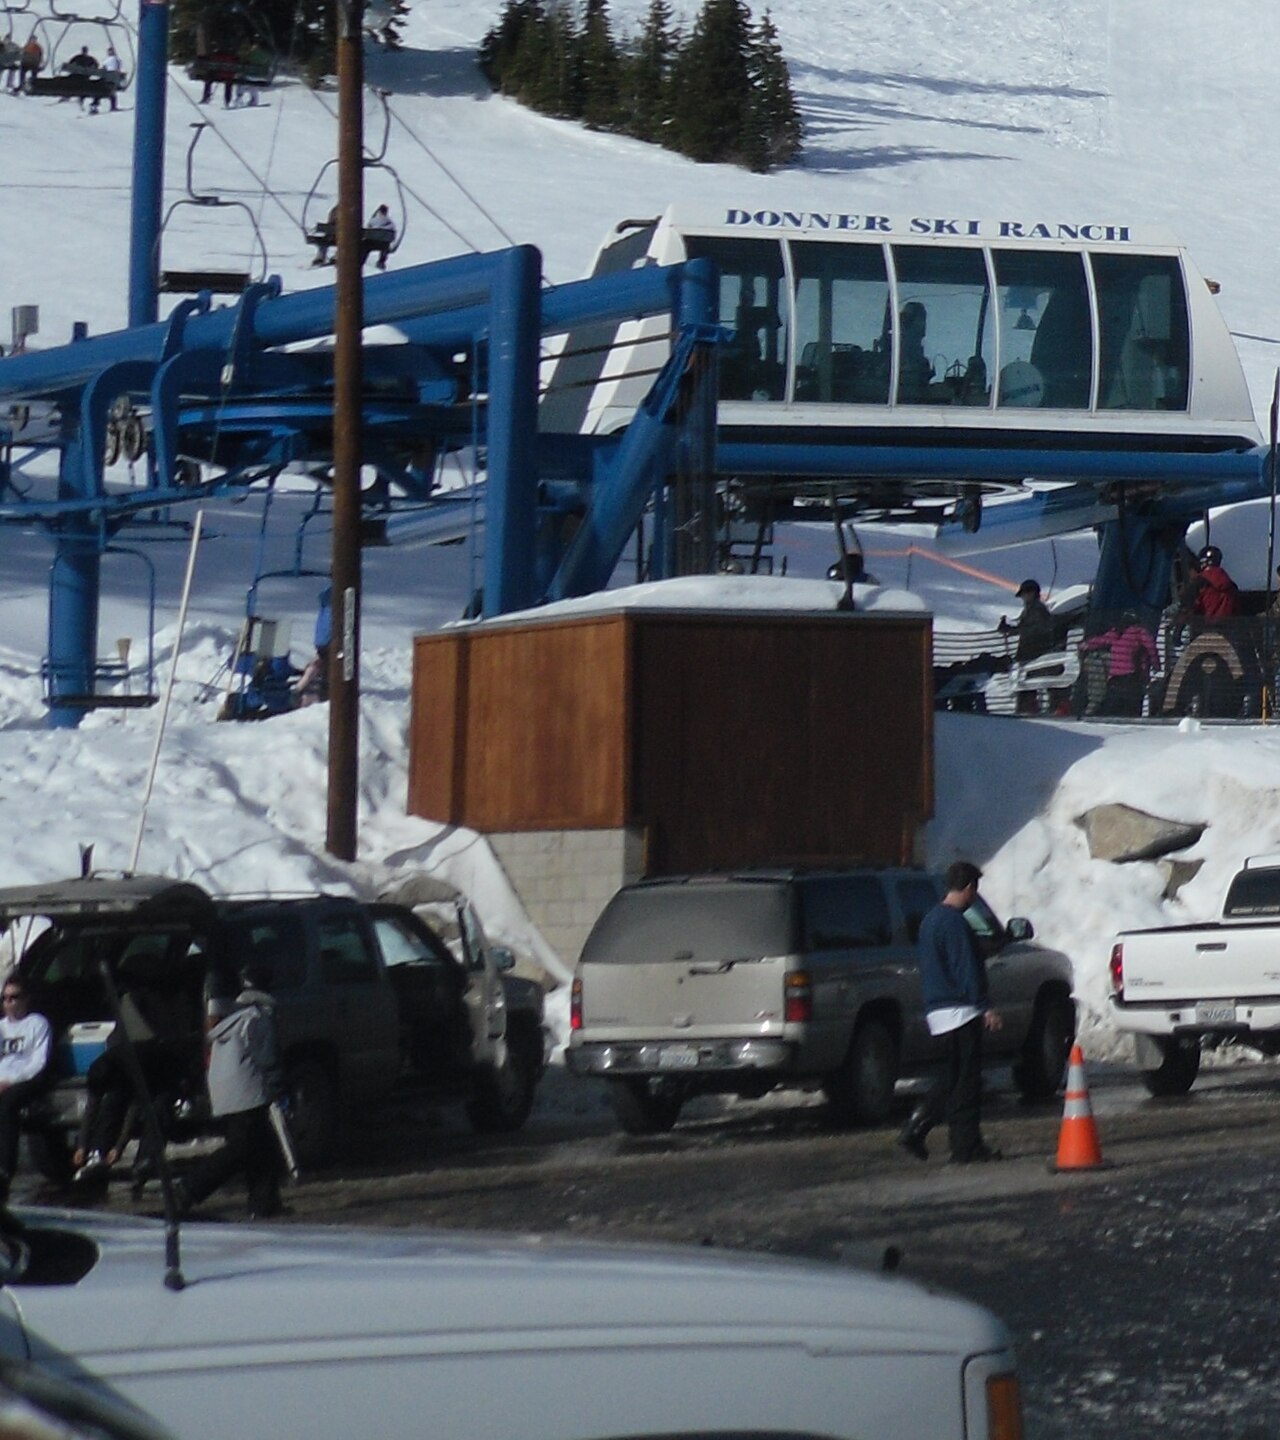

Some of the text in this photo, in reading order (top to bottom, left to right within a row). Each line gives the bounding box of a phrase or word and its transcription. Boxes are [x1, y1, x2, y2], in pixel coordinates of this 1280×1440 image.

[725, 209, 1132, 242] DONNER SKI RANCH
